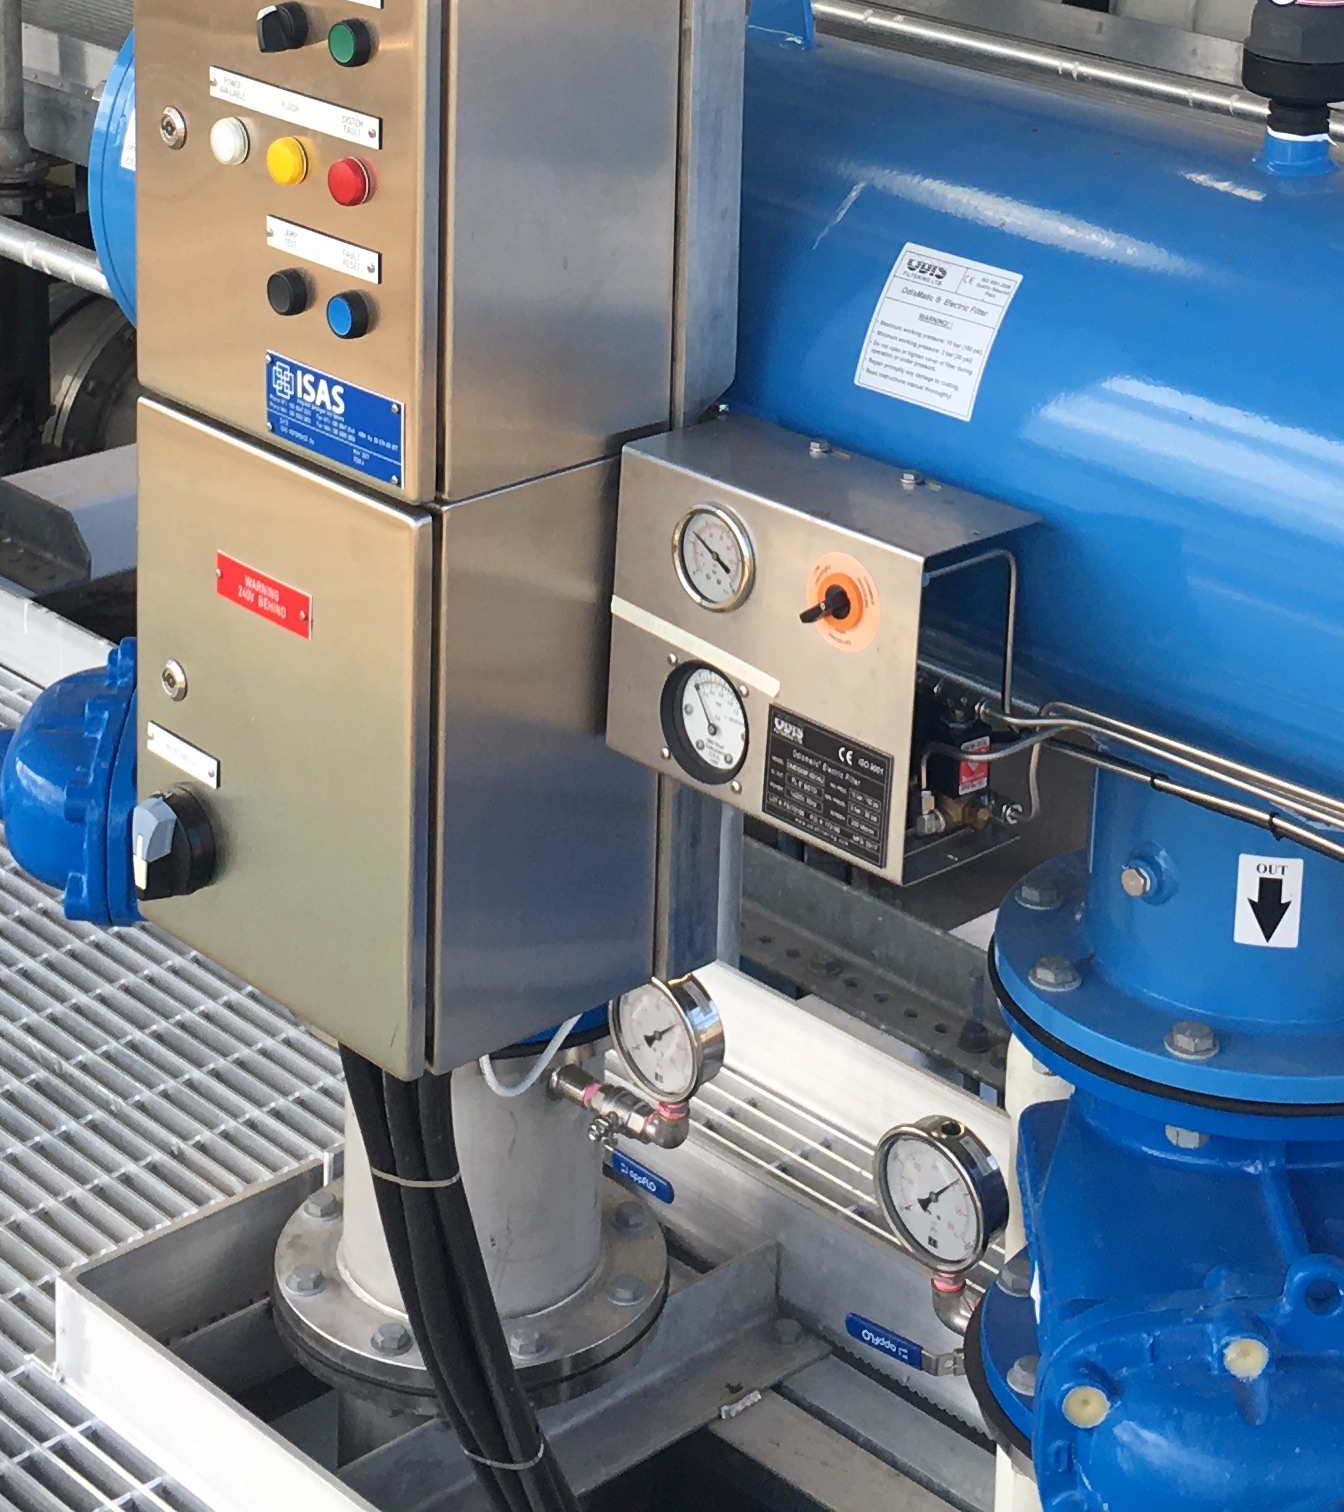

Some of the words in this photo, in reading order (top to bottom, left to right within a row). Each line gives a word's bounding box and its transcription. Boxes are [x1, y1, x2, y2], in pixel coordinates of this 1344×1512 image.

[341, 115, 364, 128] SYSTEM
[343, 124, 361, 137] FAULT
[343, 249, 360, 261] FAULT
[343, 259, 360, 271] RESET
[902, 270, 929, 282] FILTERING
[943, 298, 969, 311] Electric
[969, 306, 988, 317] Filter
[297, 369, 345, 414] ISAS
[244, 574, 279, 603] WARNING
[238, 584, 255, 603] 240V
[258, 594, 287, 619] BEHIND
[1256, 863, 1288, 876] OUT
